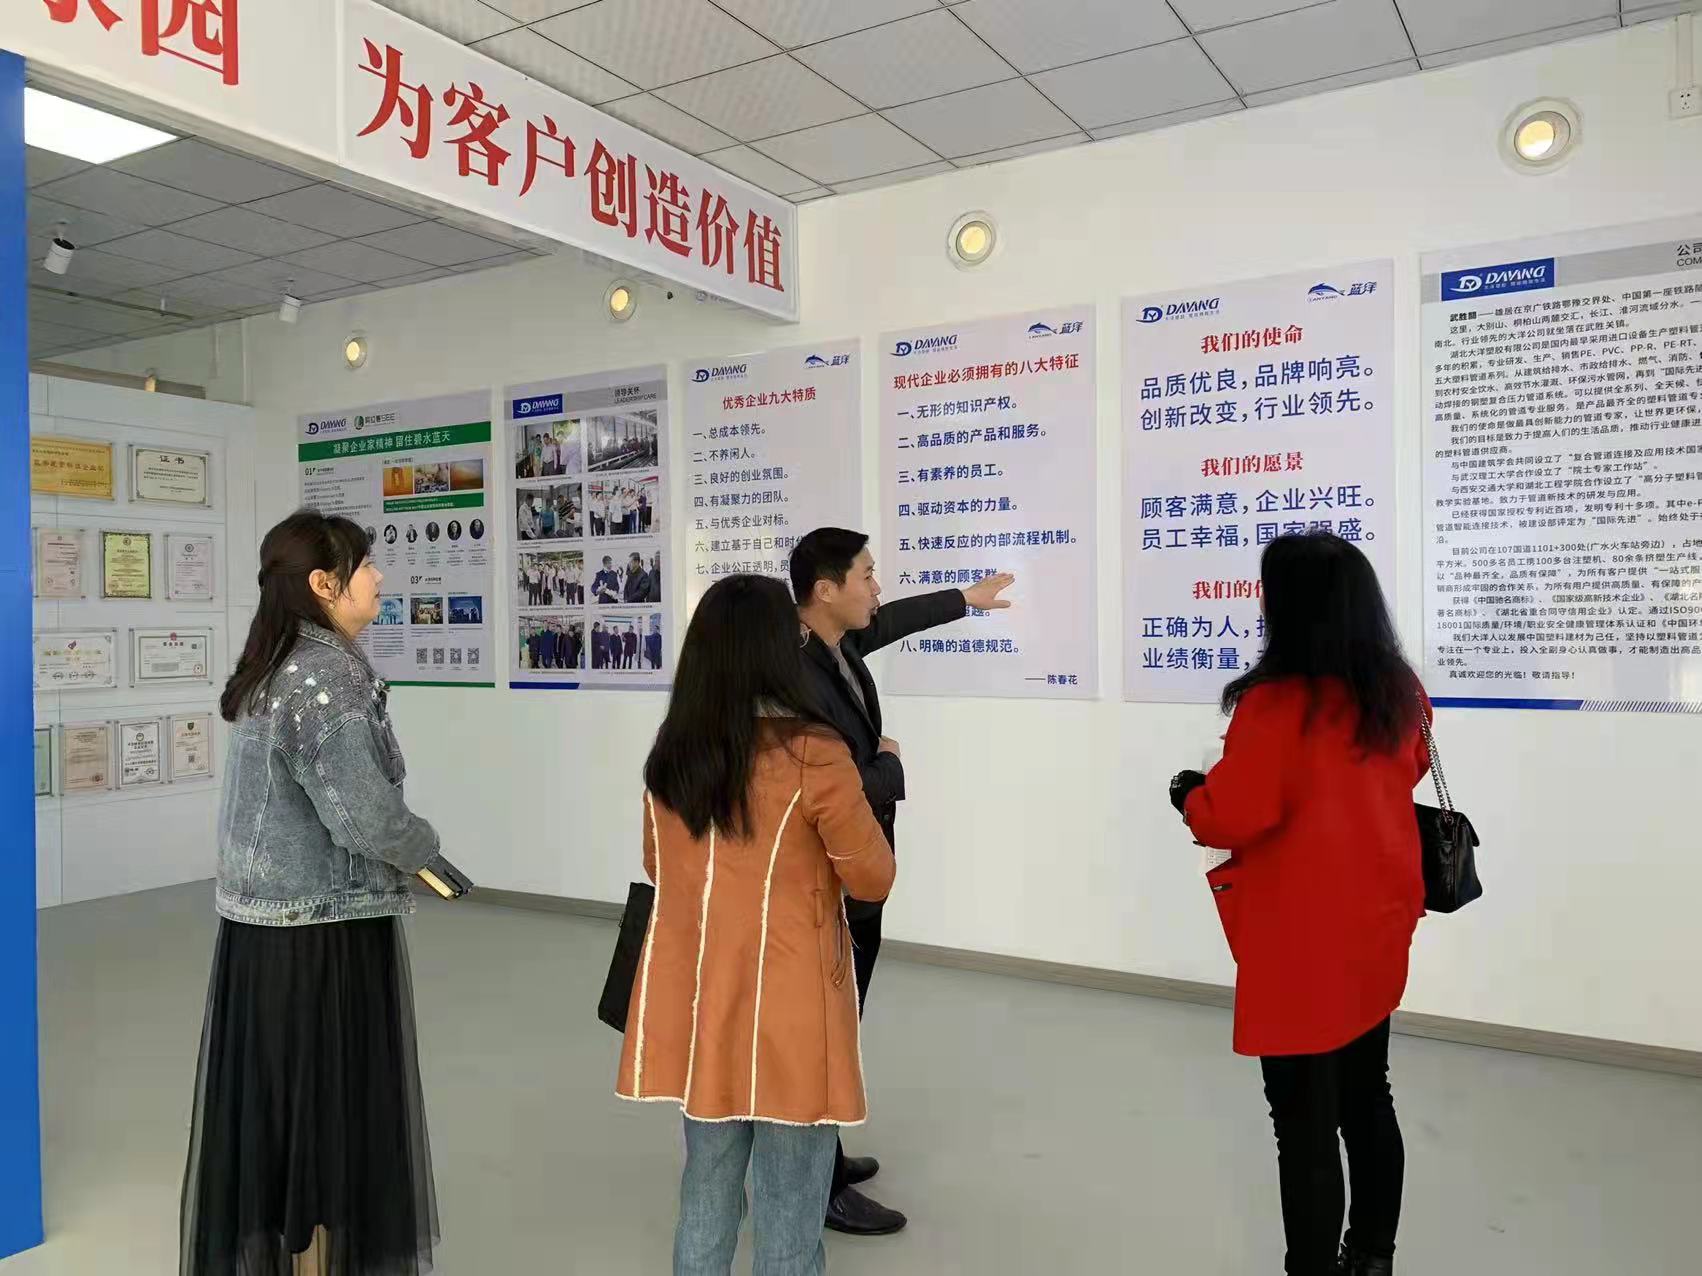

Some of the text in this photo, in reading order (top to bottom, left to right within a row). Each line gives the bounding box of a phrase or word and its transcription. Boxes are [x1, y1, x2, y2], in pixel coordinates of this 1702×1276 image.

[356, 37, 784, 292] 为客户创造价值
[1485, 265, 1546, 284] DAYANG
[1347, 281, 1377, 296] 蓝洋
[1166, 297, 1220, 316] DAYANG
[914, 334, 958, 350] DAYANG
[1200, 324, 1304, 354] 我们的使命
[711, 363, 747, 377] DAYANG
[893, 353, 1080, 390] 现代企业必须拥有的八大特征
[1140, 354, 1374, 400] 品质优良，品牌响亮。
[722, 386, 817, 411] 优秀企业九大特质
[897, 395, 1018, 420] 一、无形的知识产权。
[1140, 388, 1374, 431] 创新改变，行业领先。
[692, 422, 766, 440] 一、总成本领先。
[898, 423, 1047, 449] 二、高品质的产品和服务。
[333, 436, 394, 454] 凝聚企业家精神
[693, 446, 755, 463] 二、不养闲人。
[898, 463, 1004, 483] 三、有素养的员工。
[1200, 452, 1304, 477] 我们的愿景
[693, 467, 789, 486] 三、良好的创业氛围。
[694, 489, 789, 508] 四、有凝聚力的团队。
[898, 497, 1018, 517] 四、驱动资本的力量。
[1140, 485, 1375, 519] 顾客满意，企业兴旺。
[695, 513, 789, 530] 五、与优秀企业对标。
[898, 529, 1077, 551] 五、快速反应的内部流程机制。
[900, 639, 1020, 653] 八、明确的道德规范。
[1142, 647, 1264, 671] 业绩衡量，
